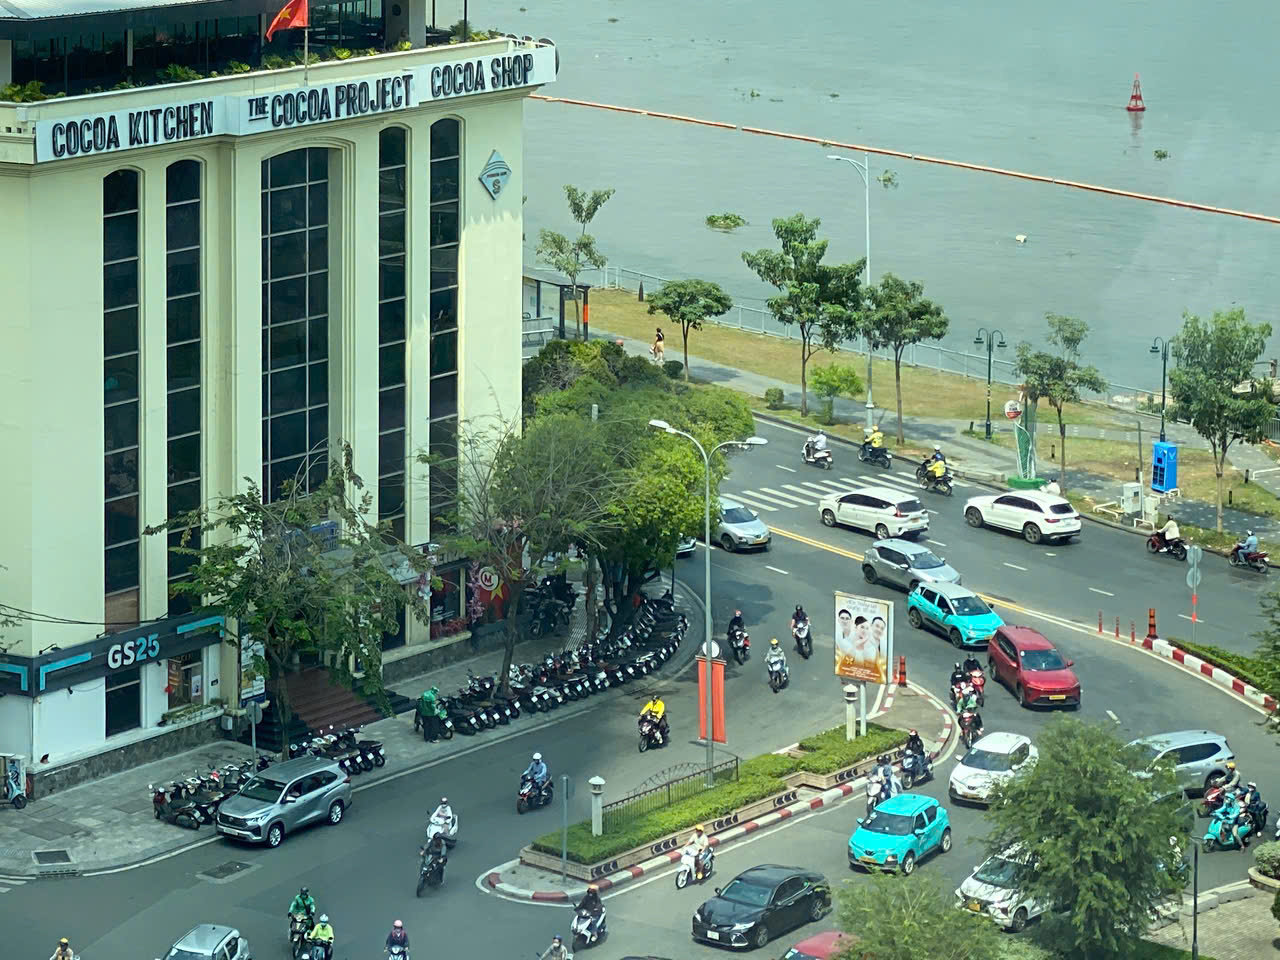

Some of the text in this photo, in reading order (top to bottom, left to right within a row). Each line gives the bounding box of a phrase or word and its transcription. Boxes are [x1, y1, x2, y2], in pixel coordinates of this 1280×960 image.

[431, 53, 534, 97] COCOA SHOP
[248, 74, 413, 127] THE COCOA PROJECT
[52, 101, 214, 157] COCOA KITCHEN
[107, 633, 160, 669] GS25
